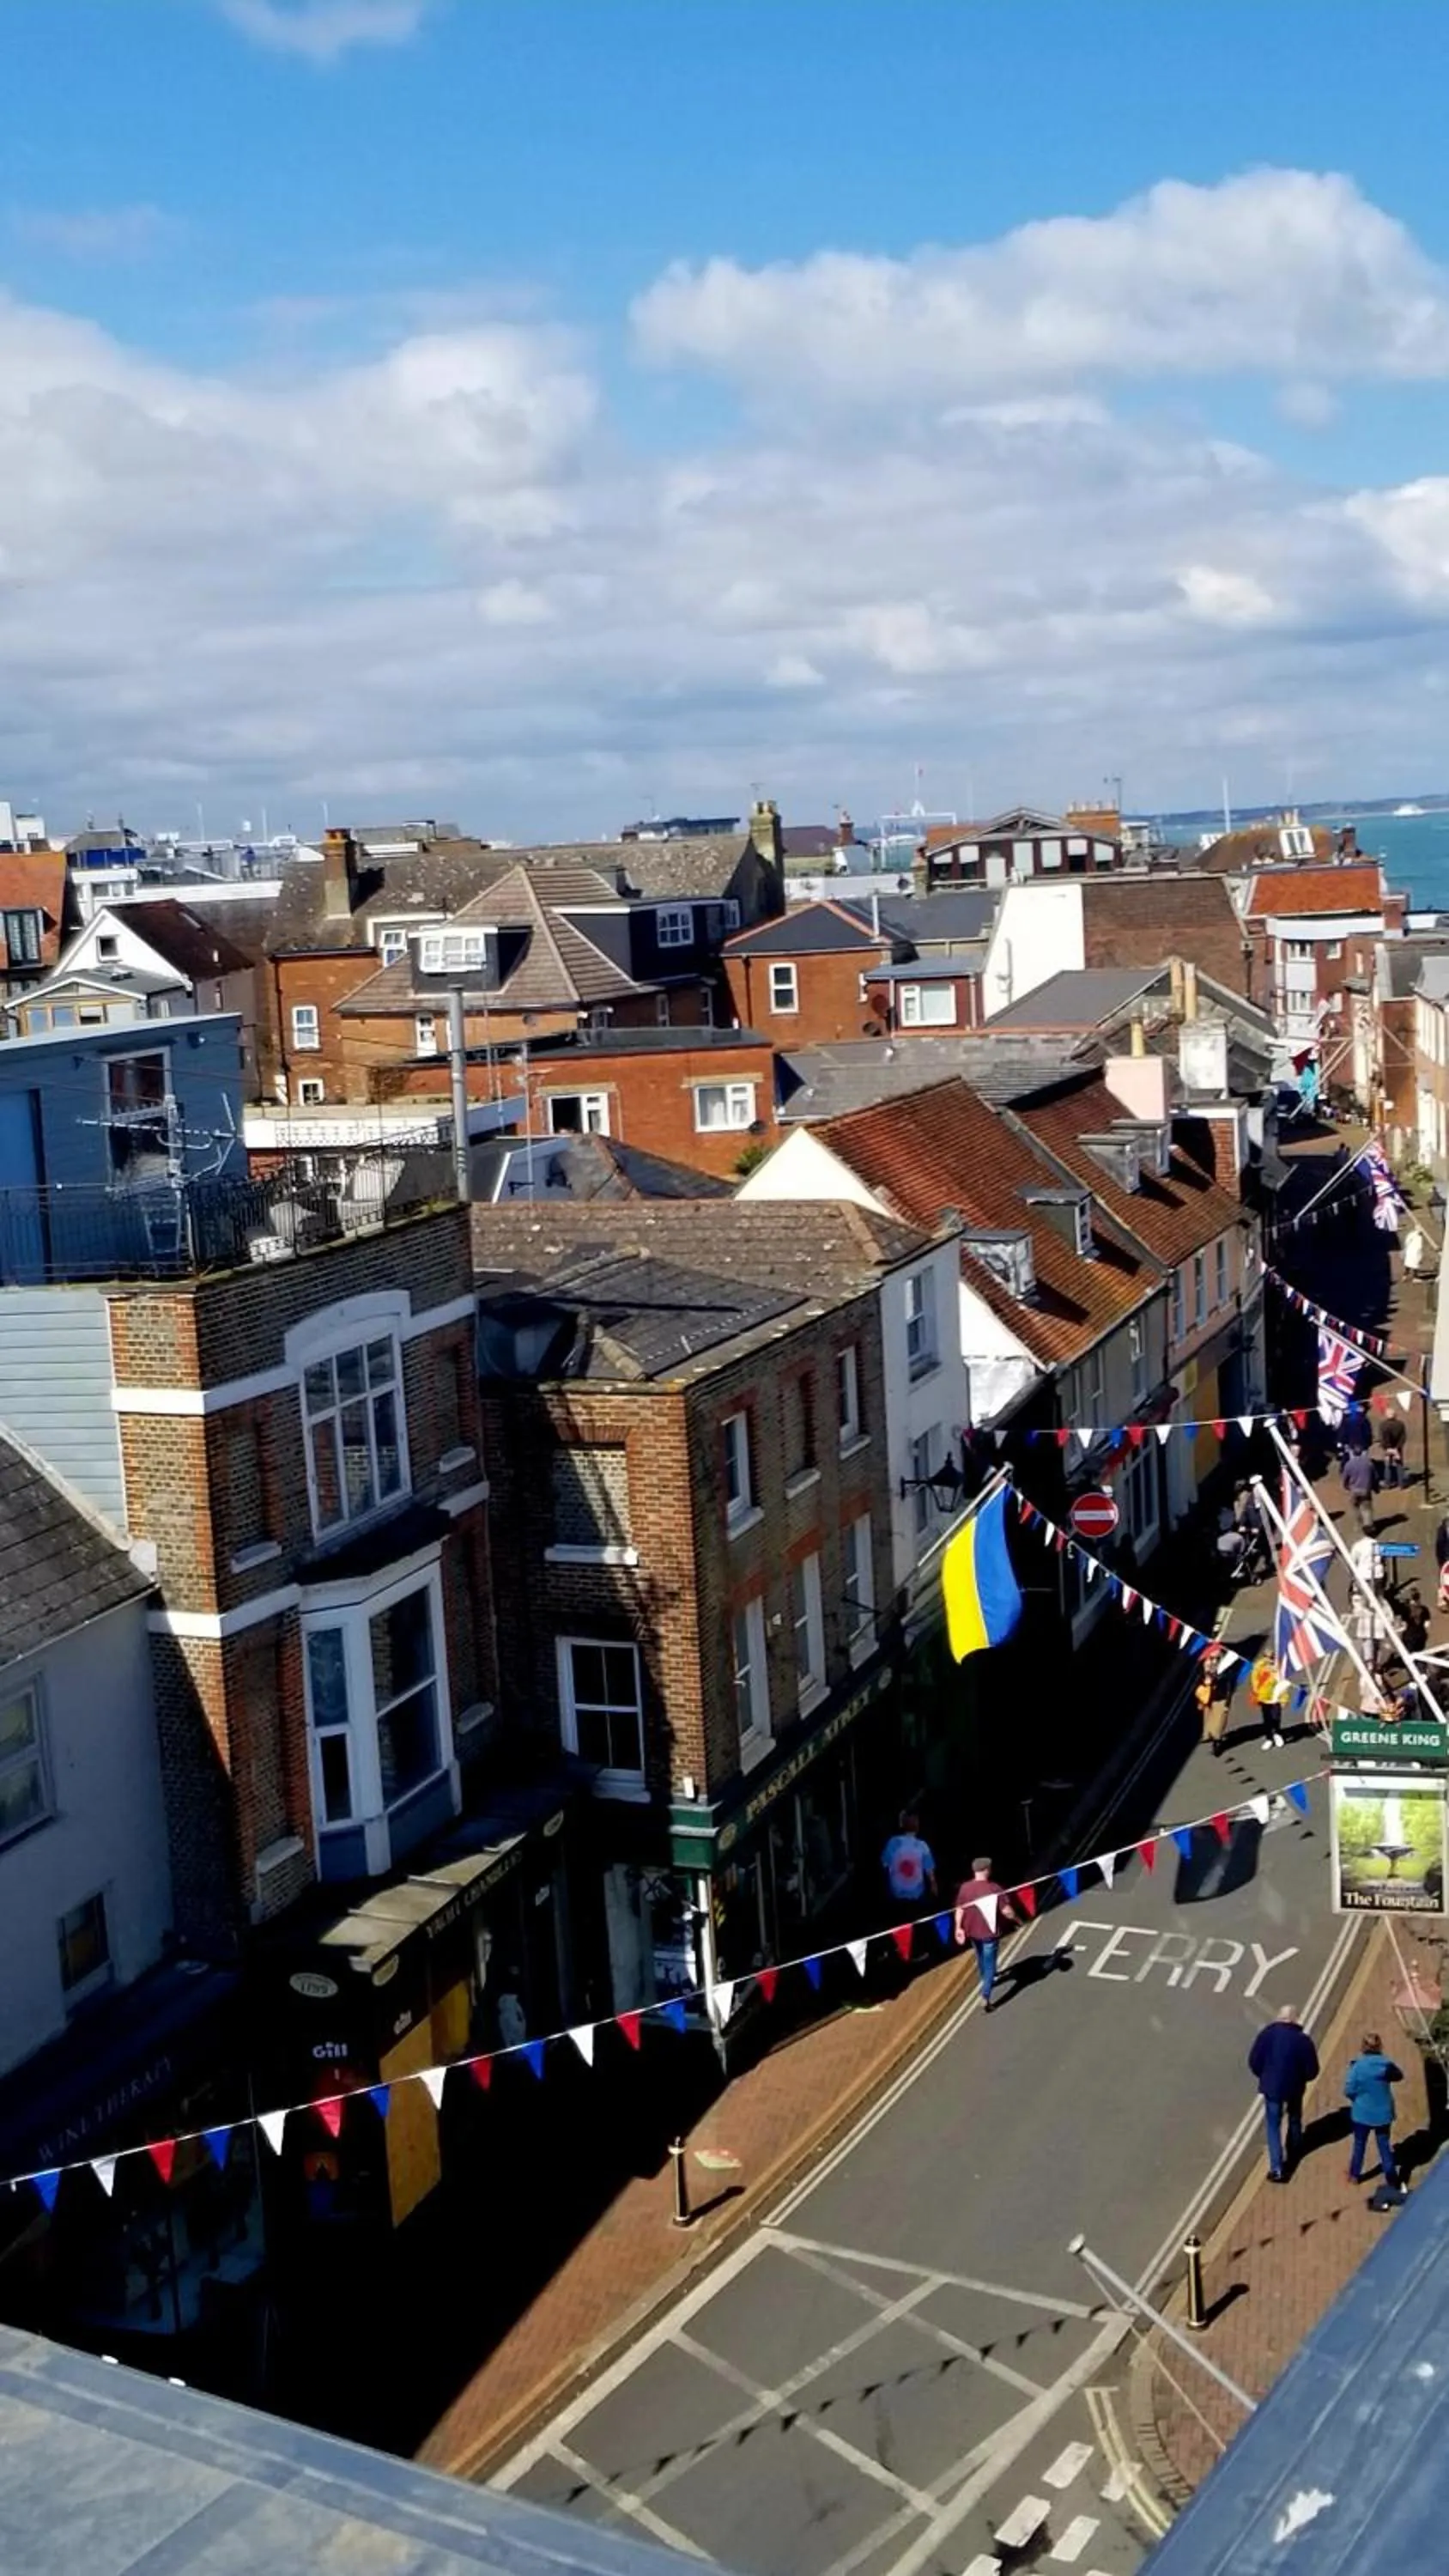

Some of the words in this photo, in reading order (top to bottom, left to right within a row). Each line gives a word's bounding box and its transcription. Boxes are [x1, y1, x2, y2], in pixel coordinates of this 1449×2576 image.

[1340, 1730, 1398, 1745] GREENE
[1402, 1733, 1440, 1747] KING
[1343, 1892, 1373, 1905] The
[1374, 1892, 1440, 1910] Fountain
[1051, 1920, 1300, 1997] FERRY
[312, 2040, 349, 2059] Gill
